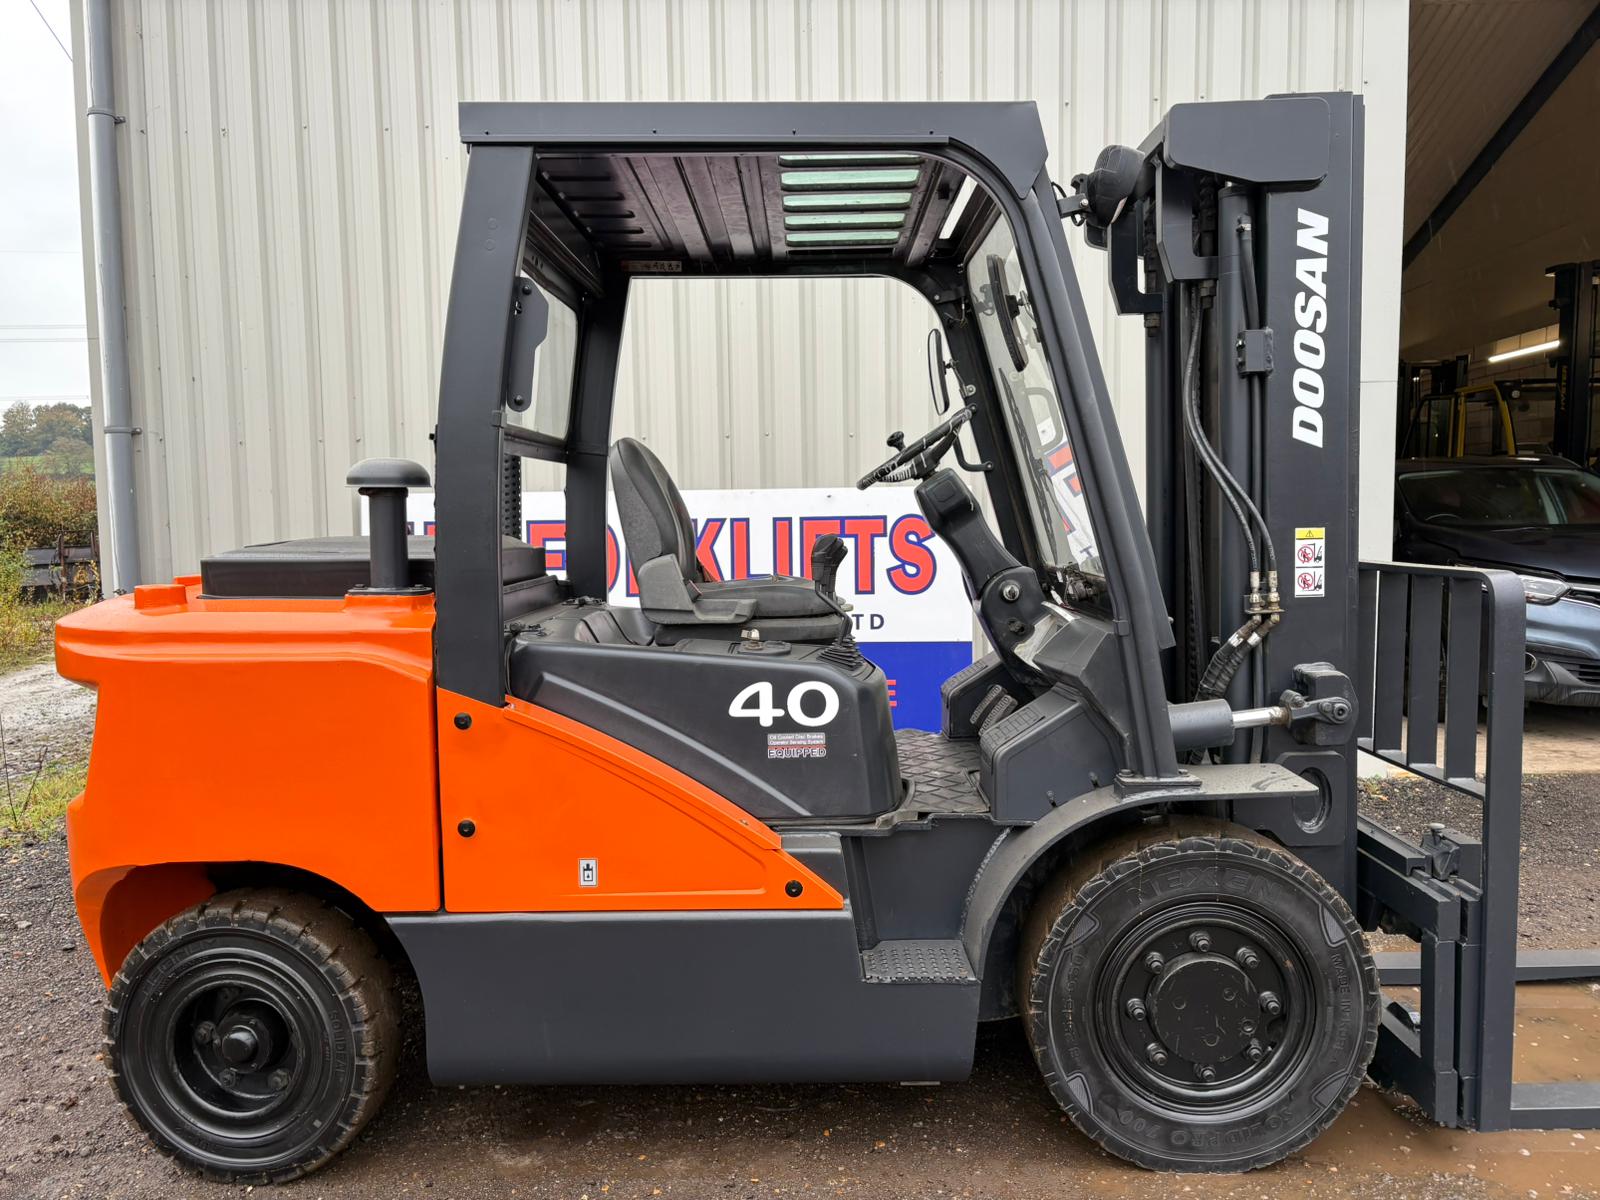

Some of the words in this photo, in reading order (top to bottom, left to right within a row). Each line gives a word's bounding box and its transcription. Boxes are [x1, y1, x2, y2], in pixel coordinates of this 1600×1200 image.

[1292, 208, 1330, 449] DOOSAN
[851, 613, 885, 630] TD
[728, 680, 840, 728] 40
[768, 748, 827, 759] EQUIPPED
